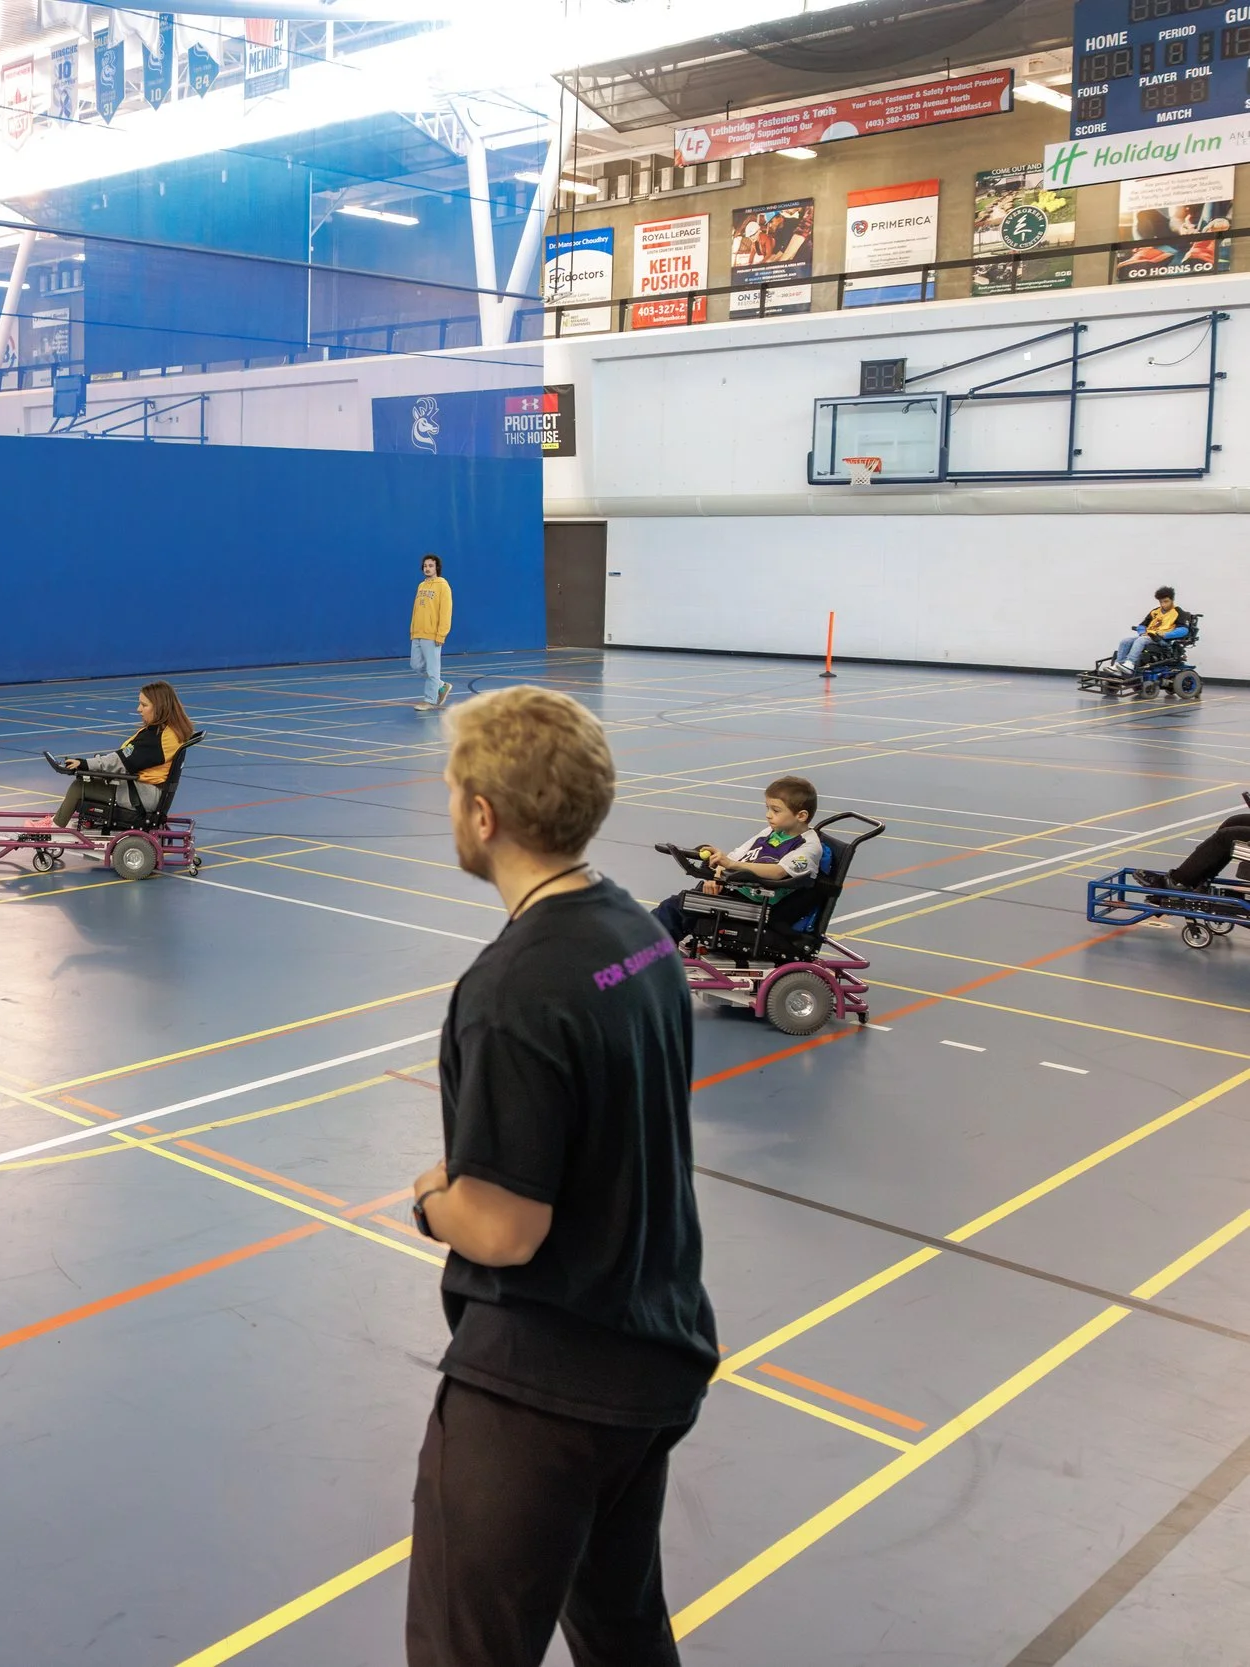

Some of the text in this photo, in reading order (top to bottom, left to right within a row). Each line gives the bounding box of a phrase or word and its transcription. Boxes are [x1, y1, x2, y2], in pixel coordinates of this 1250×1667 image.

[1225, 8, 1250, 24] GU
[1158, 25, 1196, 41] PERIOD
[1086, 31, 1128, 52] HOME
[51, 44, 78, 60] HIRSCHE
[58, 60, 72, 80] 10
[1139, 65, 1213, 88] PLAYER FOUL
[195, 74, 210, 90] 24
[150, 87, 162, 103] 10
[852, 76, 1005, 110] Your Tool, Fastener & Safety Product Provider
[1077, 84, 1109, 99] FOULS
[103, 102, 114, 116] 31
[885, 93, 970, 115] 2825 12th Avenue North
[711, 105, 837, 137] Lethbridge Fasteners & Tools
[865, 118, 884, 129] (403)
[933, 101, 992, 117] www.lethfast.ca
[1156, 108, 1192, 123] MATCH
[728, 122, 814, 143] Proudly Supporting Our
[1075, 123, 1107, 136] SCORE
[750, 136, 791, 149] Community
[1093, 140, 1182, 168] Holiday
[1183, 133, 1222, 155] Inn
[992, 167, 1011, 176] COME
[1011, 164, 1025, 172] OUT
[871, 216, 931, 231] PRIMERICA
[1005, 207, 1044, 224] EVERGREEN
[582, 236, 609, 245] Choudhry
[642, 232, 669, 242] ROYAL
[1003, 236, 1018, 248] GOLF
[650, 255, 691, 275] KEITH
[1128, 262, 1213, 278] GO HORNS GO
[641, 271, 699, 292] PUSHOR
[738, 293, 750, 302] ON
[638, 298, 701, 316] 403-327-211
[504, 413, 558, 432] PROTECT
[505, 430, 562, 445] THIS HOUSE.
[593, 963, 627, 991] FOR
